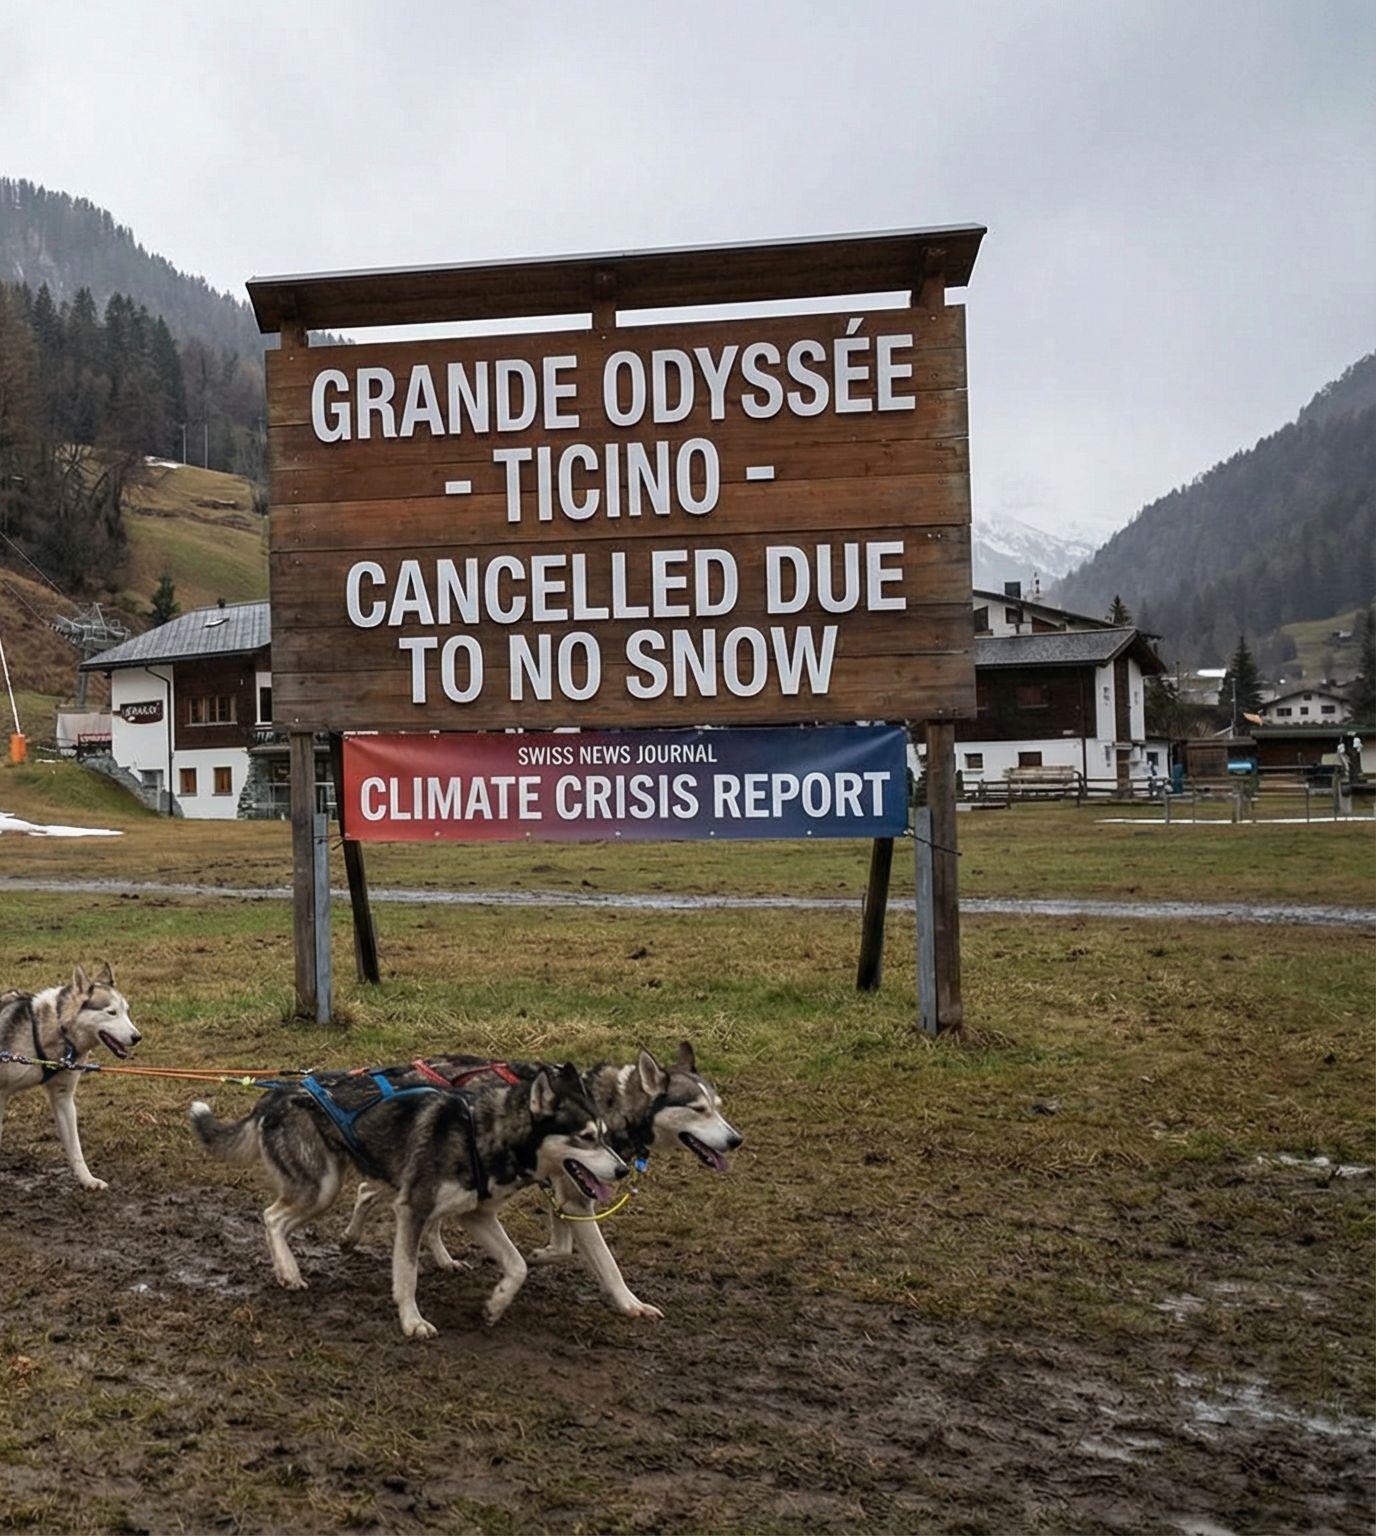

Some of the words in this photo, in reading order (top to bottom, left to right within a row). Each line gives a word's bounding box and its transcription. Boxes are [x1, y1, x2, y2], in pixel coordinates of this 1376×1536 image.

[311, 355, 581, 443] GRANDE
[603, 317, 917, 426] ODYSSÉE
[445, 480, 472, 495] -
[493, 437, 720, 522] TICINO
[746, 465, 775, 480] -
[346, 548, 738, 628] CANCELLED
[766, 540, 907, 614] DUE
[398, 635, 484, 703] TO
[509, 631, 601, 701] NO
[626, 625, 839, 699] SNOW
[518, 746, 574, 766] SWISS
[579, 745, 631, 765] NEWS
[636, 744, 718, 764] JOURNAL
[360, 775, 543, 821] CLIMATE
[555, 773, 700, 820] CRISIS
[713, 771, 891, 819] REPORT
